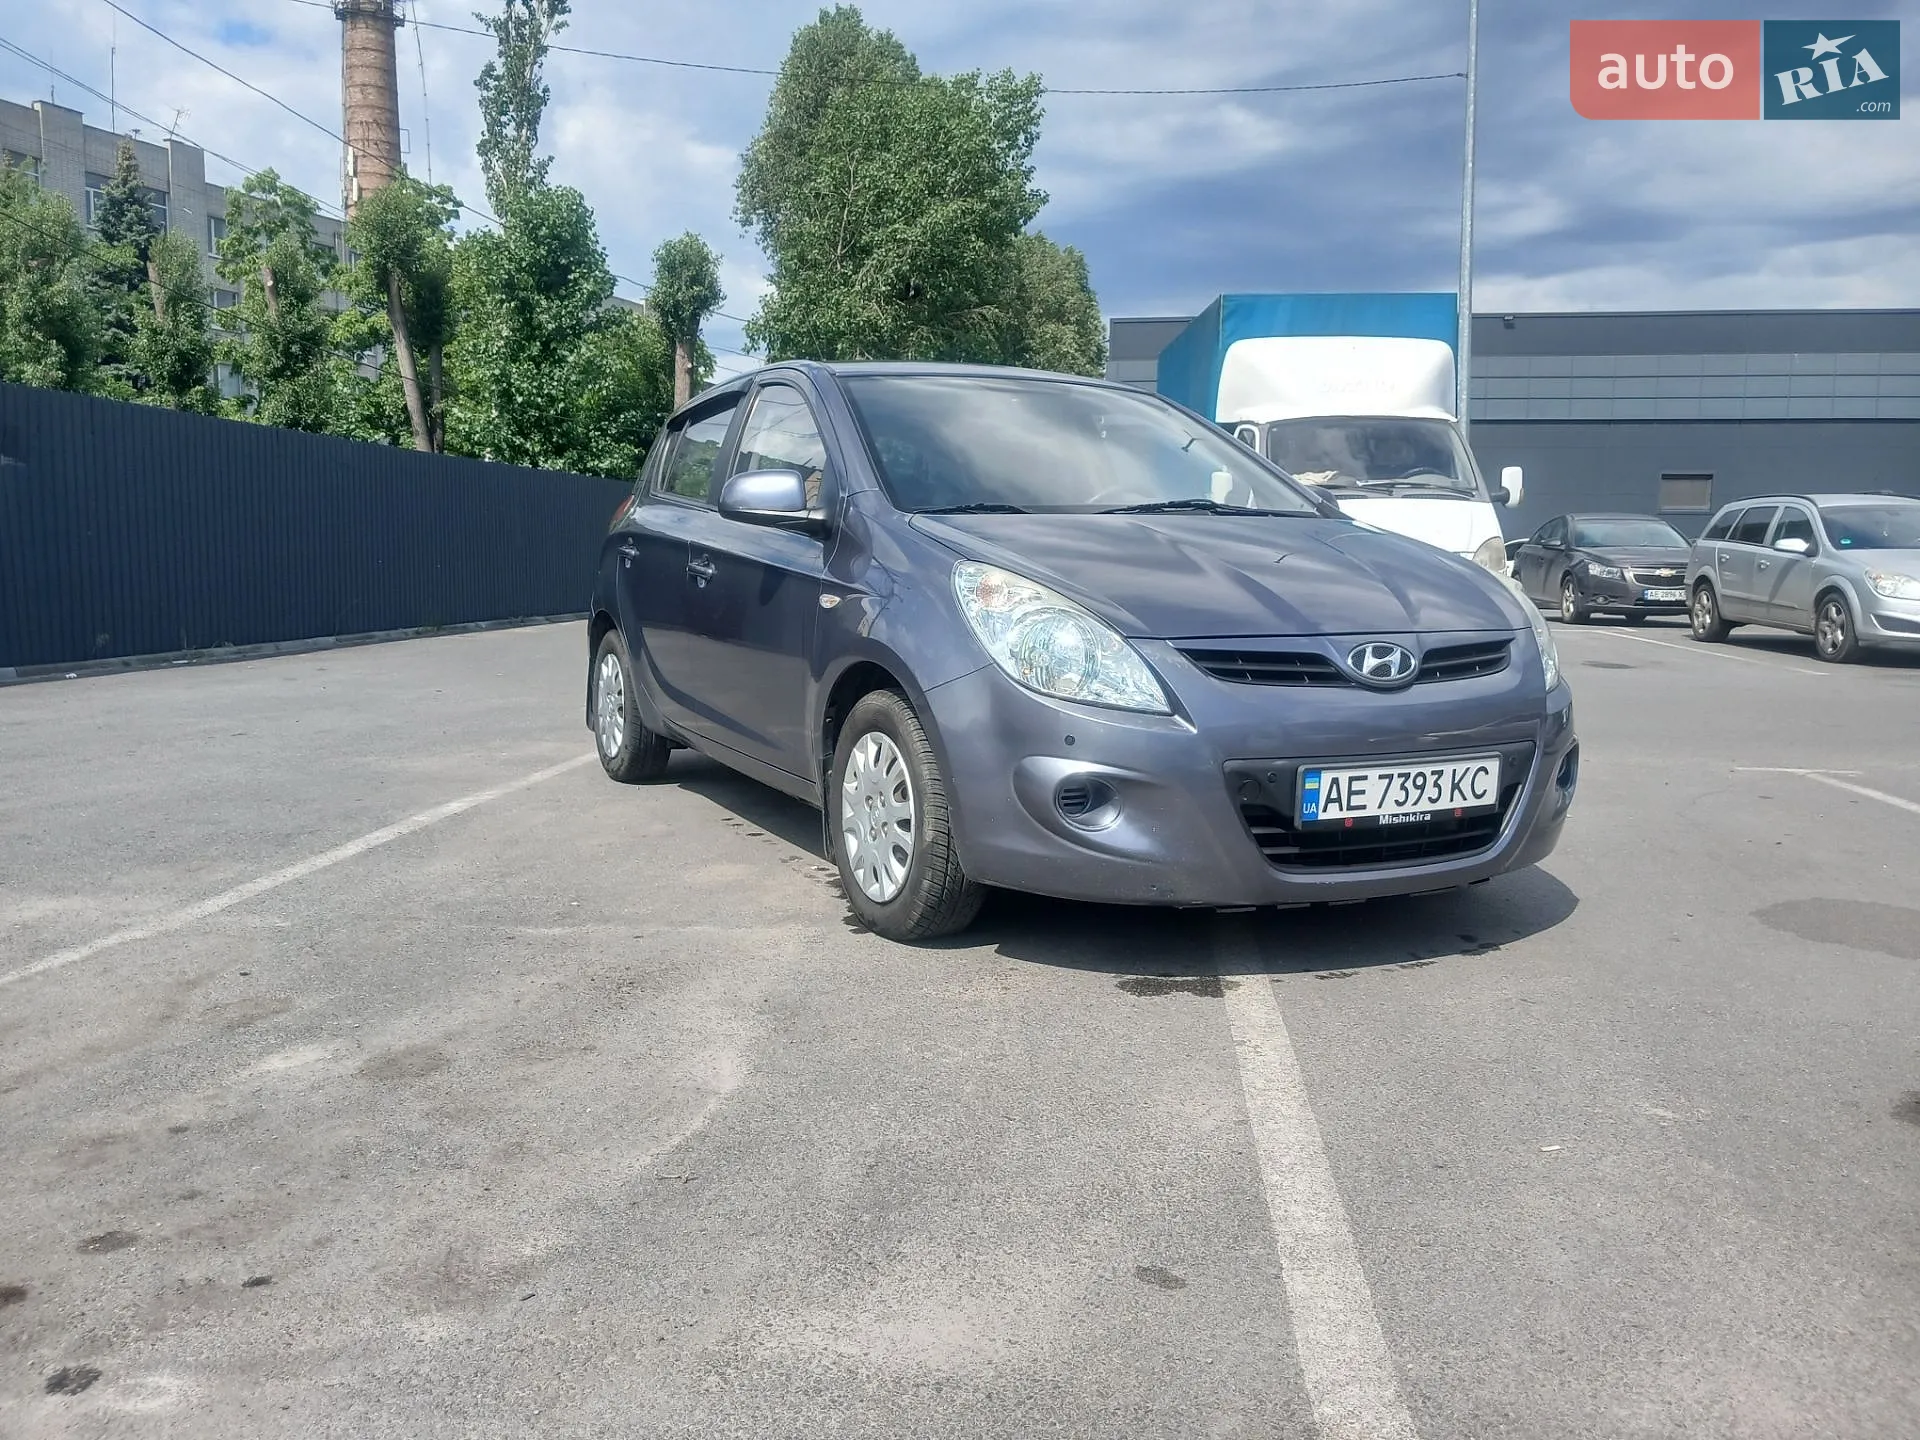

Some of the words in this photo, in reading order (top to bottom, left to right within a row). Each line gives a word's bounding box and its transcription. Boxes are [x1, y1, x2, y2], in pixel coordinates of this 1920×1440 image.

[1322, 774, 1369, 813] AE
[1376, 769, 1444, 809] 7393
[1449, 765, 1489, 803] KC
[1303, 802, 1317, 814] UA
